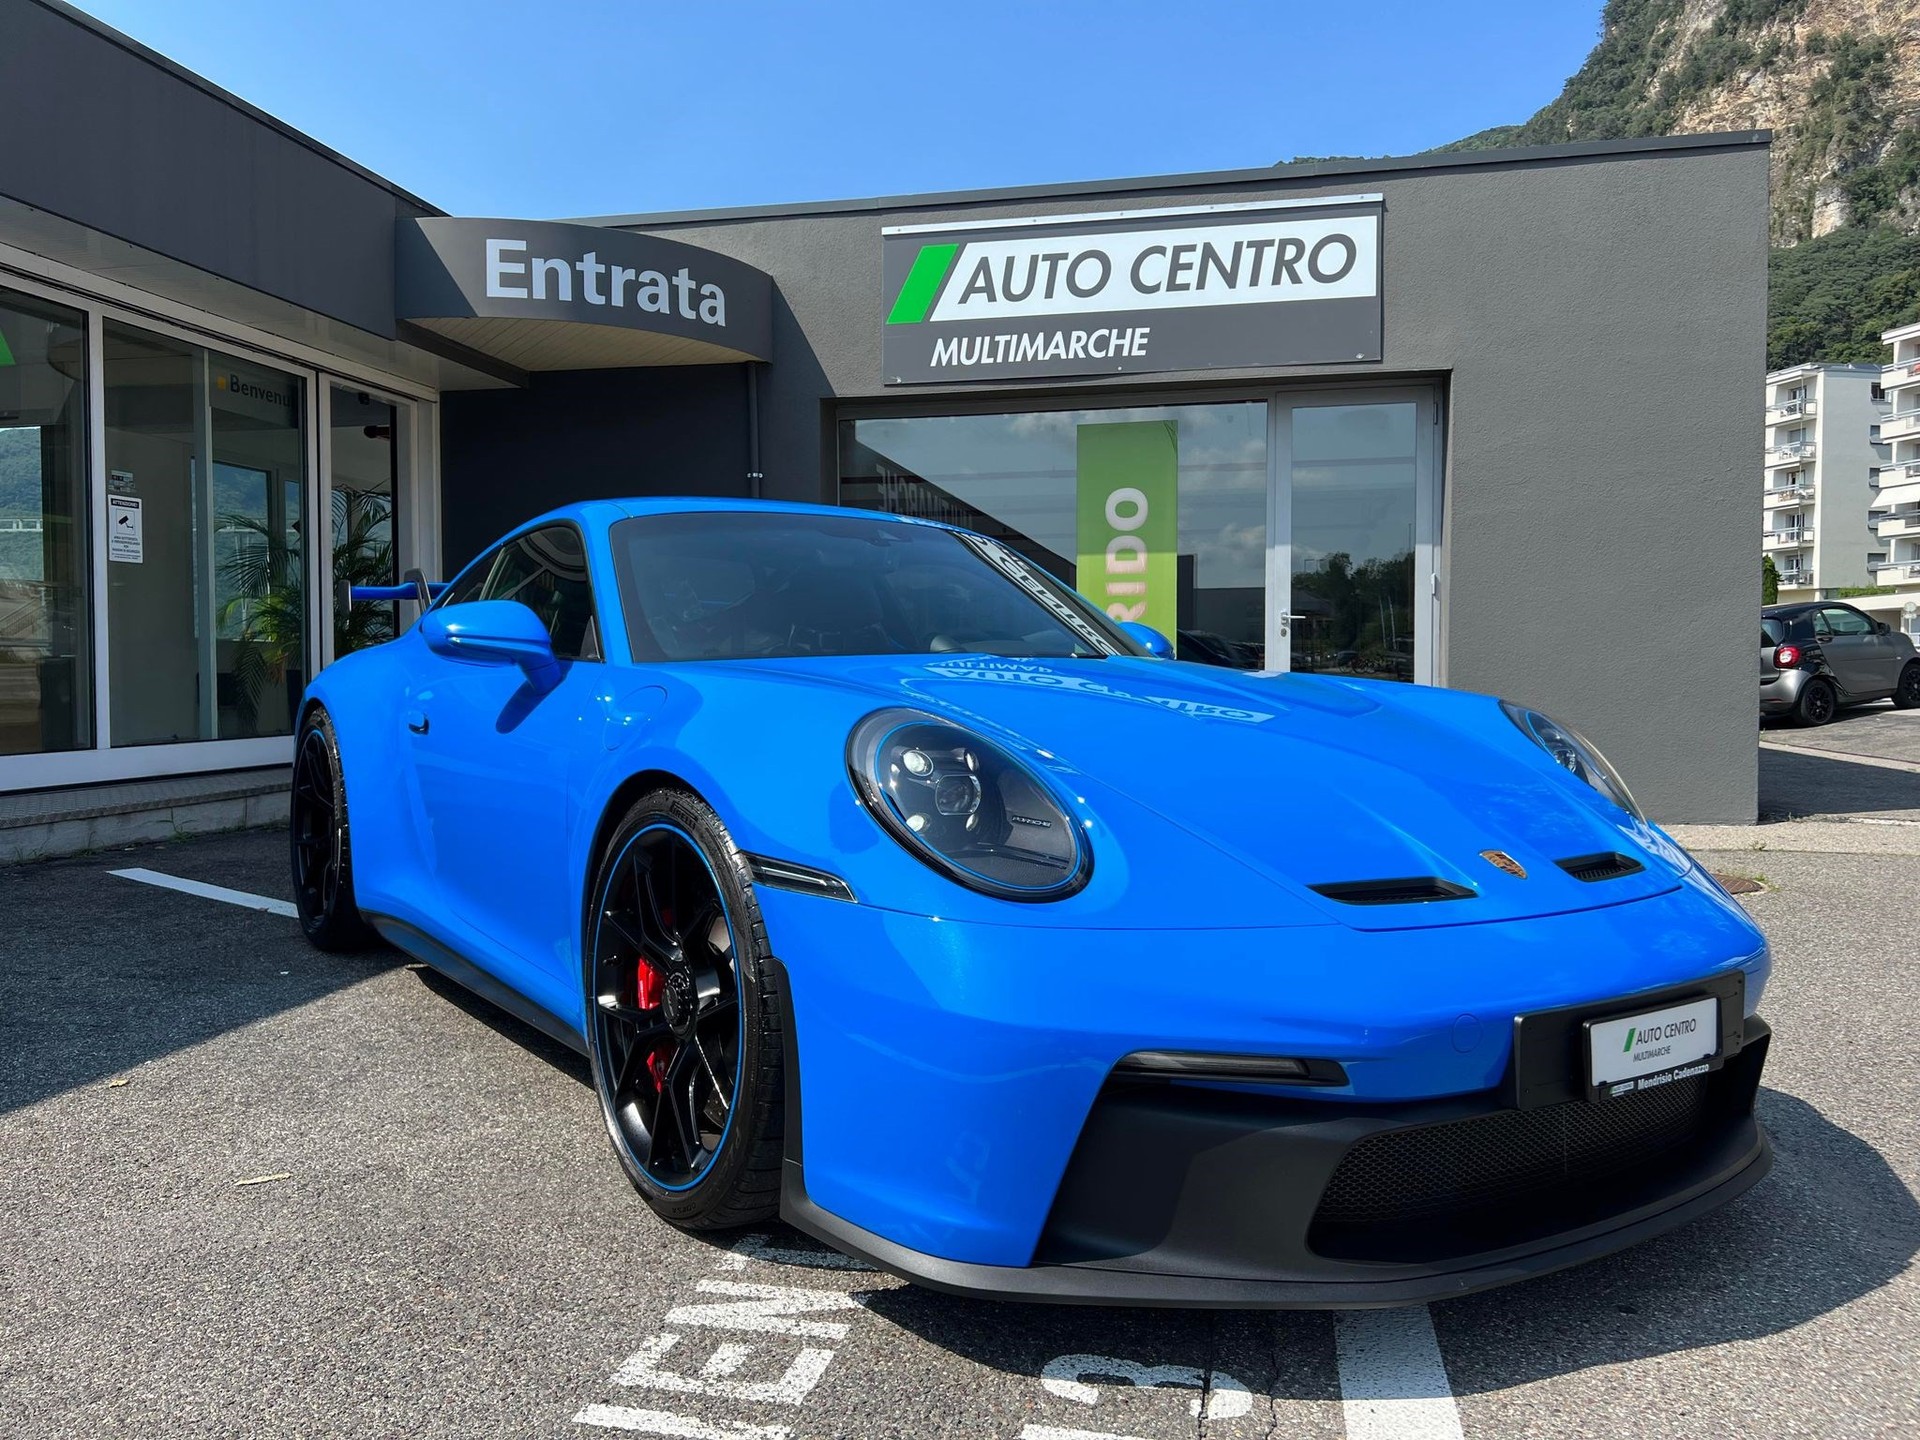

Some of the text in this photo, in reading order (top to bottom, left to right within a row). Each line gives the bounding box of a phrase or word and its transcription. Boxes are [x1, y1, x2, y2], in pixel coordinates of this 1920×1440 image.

[485, 239, 726, 327] Entrata
[958, 233, 1357, 305] AUTO CENTRO
[930, 328, 1150, 367] MULTIMARCHE
[1636, 1018, 1697, 1045] AUTO CENTRO
[1633, 1045, 1671, 1062] MULTIMARCHE
[1637, 1073, 1672, 1090] Mendrisio
[1673, 1063, 1709, 1080] Cadenazzo
